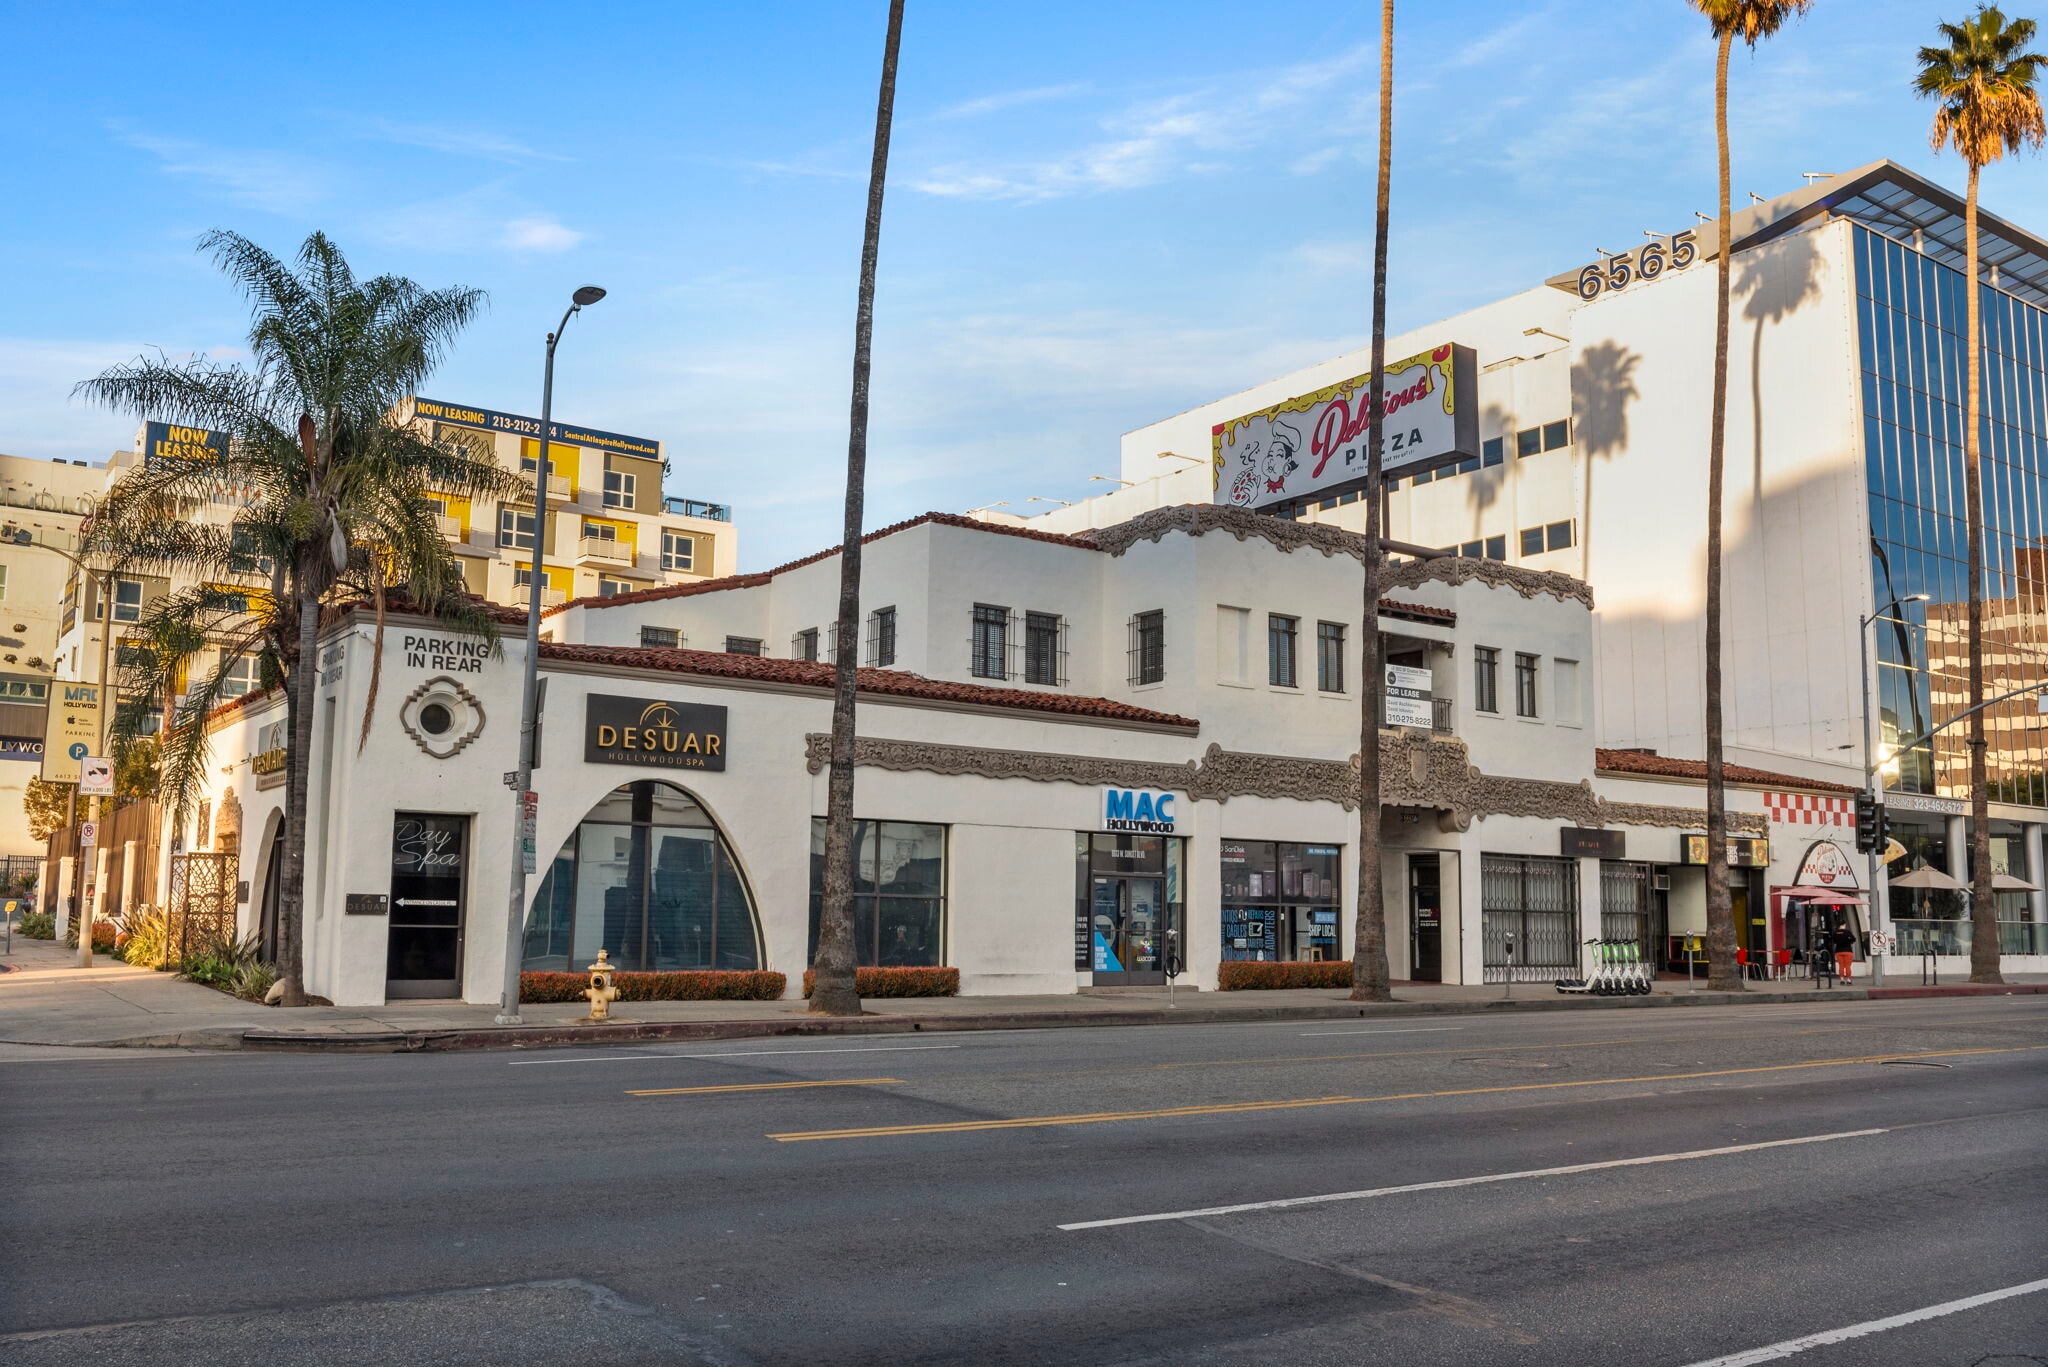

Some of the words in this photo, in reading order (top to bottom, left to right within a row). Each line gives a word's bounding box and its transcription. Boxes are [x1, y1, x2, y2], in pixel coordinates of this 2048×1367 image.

[1578, 229, 1696, 300] 6565
[417, 402, 443, 417] NOW
[445, 407, 485, 424] LEASING
[493, 416, 557, 438] 213-212-24
[169, 425, 209, 446] NOW
[404, 635, 490, 658] PARKING
[407, 652, 425, 669] IN
[431, 655, 483, 674] REAR
[1386, 687, 1399, 696] FOR
[1400, 689, 1420, 698] LEASE
[598, 725, 721, 756] DESUAR
[75, 746, 84, 758] P
[608, 752, 682, 765] HOLLYWOOD
[686, 758, 705, 767] SPA
[1106, 789, 1175, 822] MAC
[395, 820, 451, 852] Day
[1106, 818, 1175, 833] HOLLYWOOD
[394, 840, 459, 871] Spa
[1225, 845, 1245, 853] SanDisk
[1226, 923, 1248, 938] CABLES
[1264, 910, 1276, 950] ADAPTERS
[1308, 924, 1321, 937] SHOP
[1321, 924, 1337, 937] LOCAL
